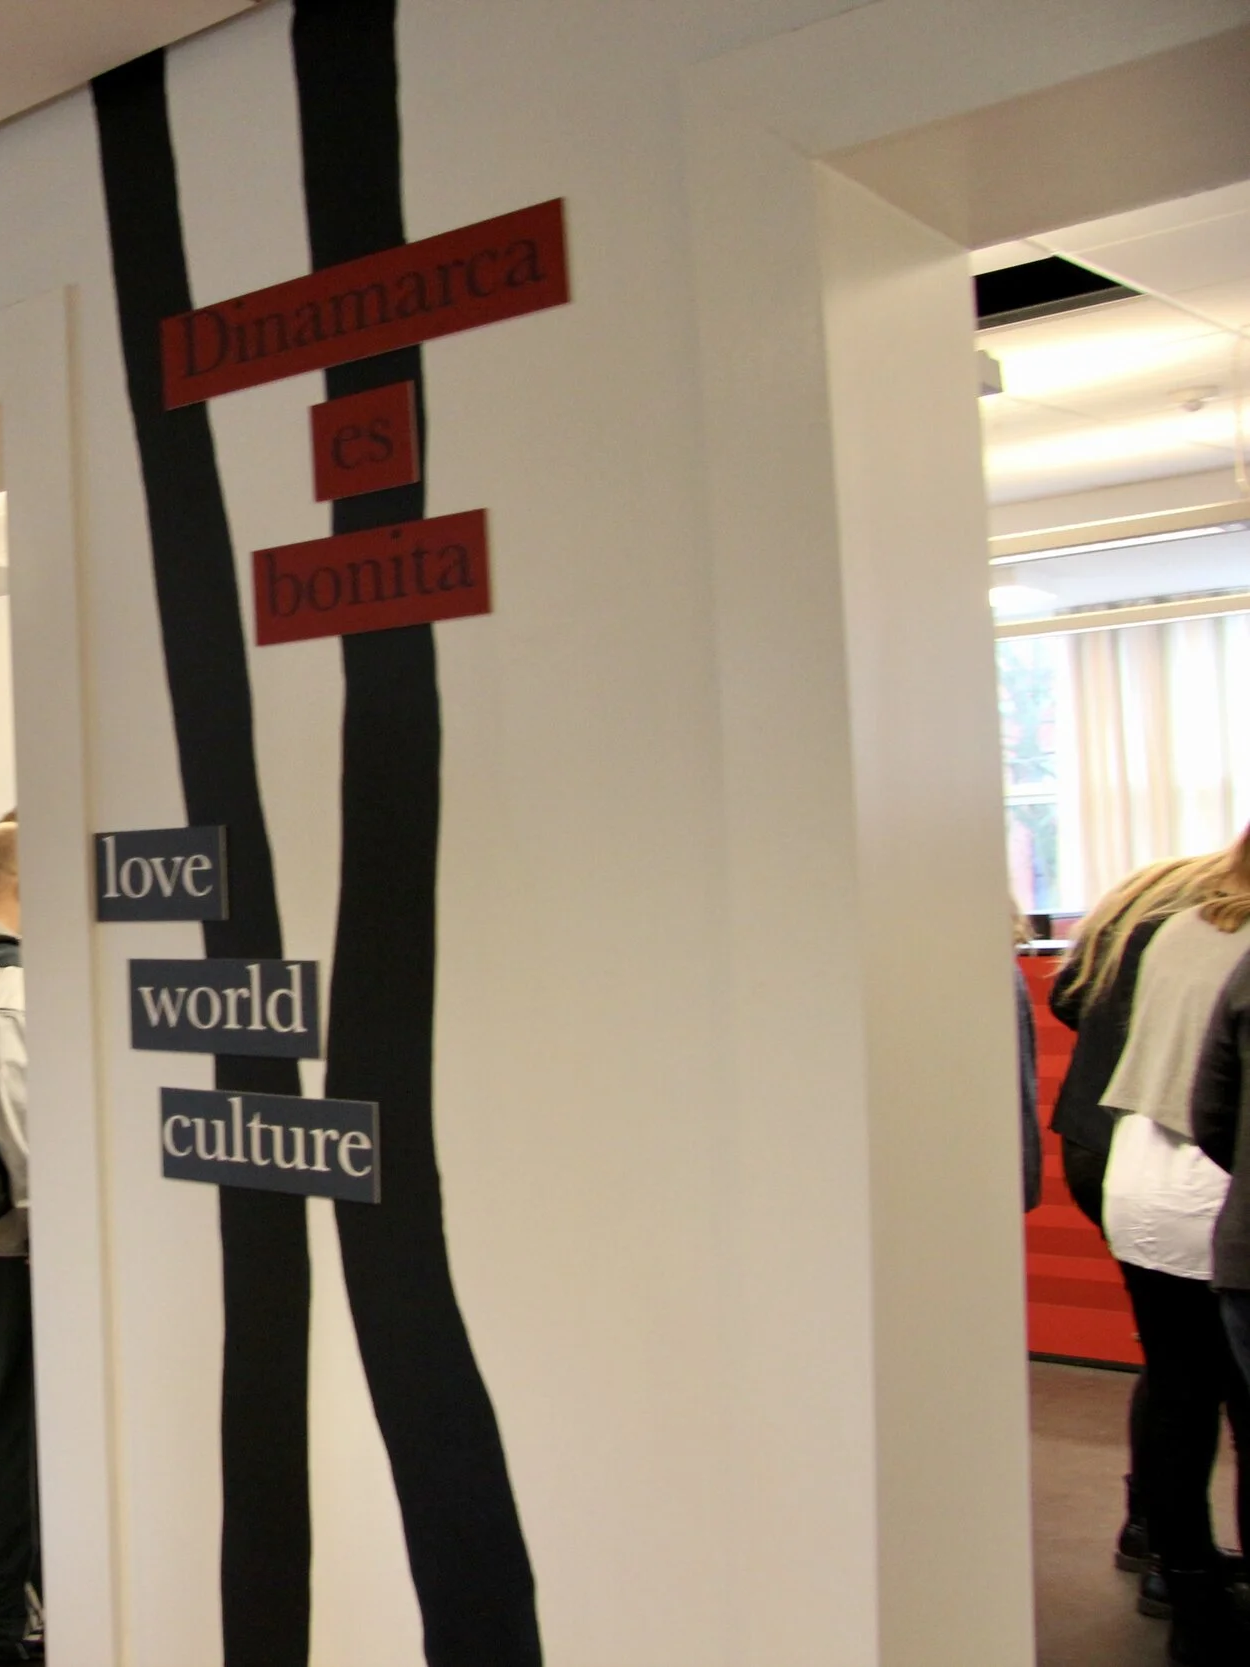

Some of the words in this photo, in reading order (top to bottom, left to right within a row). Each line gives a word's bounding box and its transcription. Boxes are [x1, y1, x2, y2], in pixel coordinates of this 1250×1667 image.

[181, 235, 546, 379] Dinamarca
[331, 416, 394, 471] es
[263, 529, 475, 619] bonita
[101, 835, 214, 899] love
[137, 962, 308, 1033] world
[162, 1096, 373, 1178] culture
